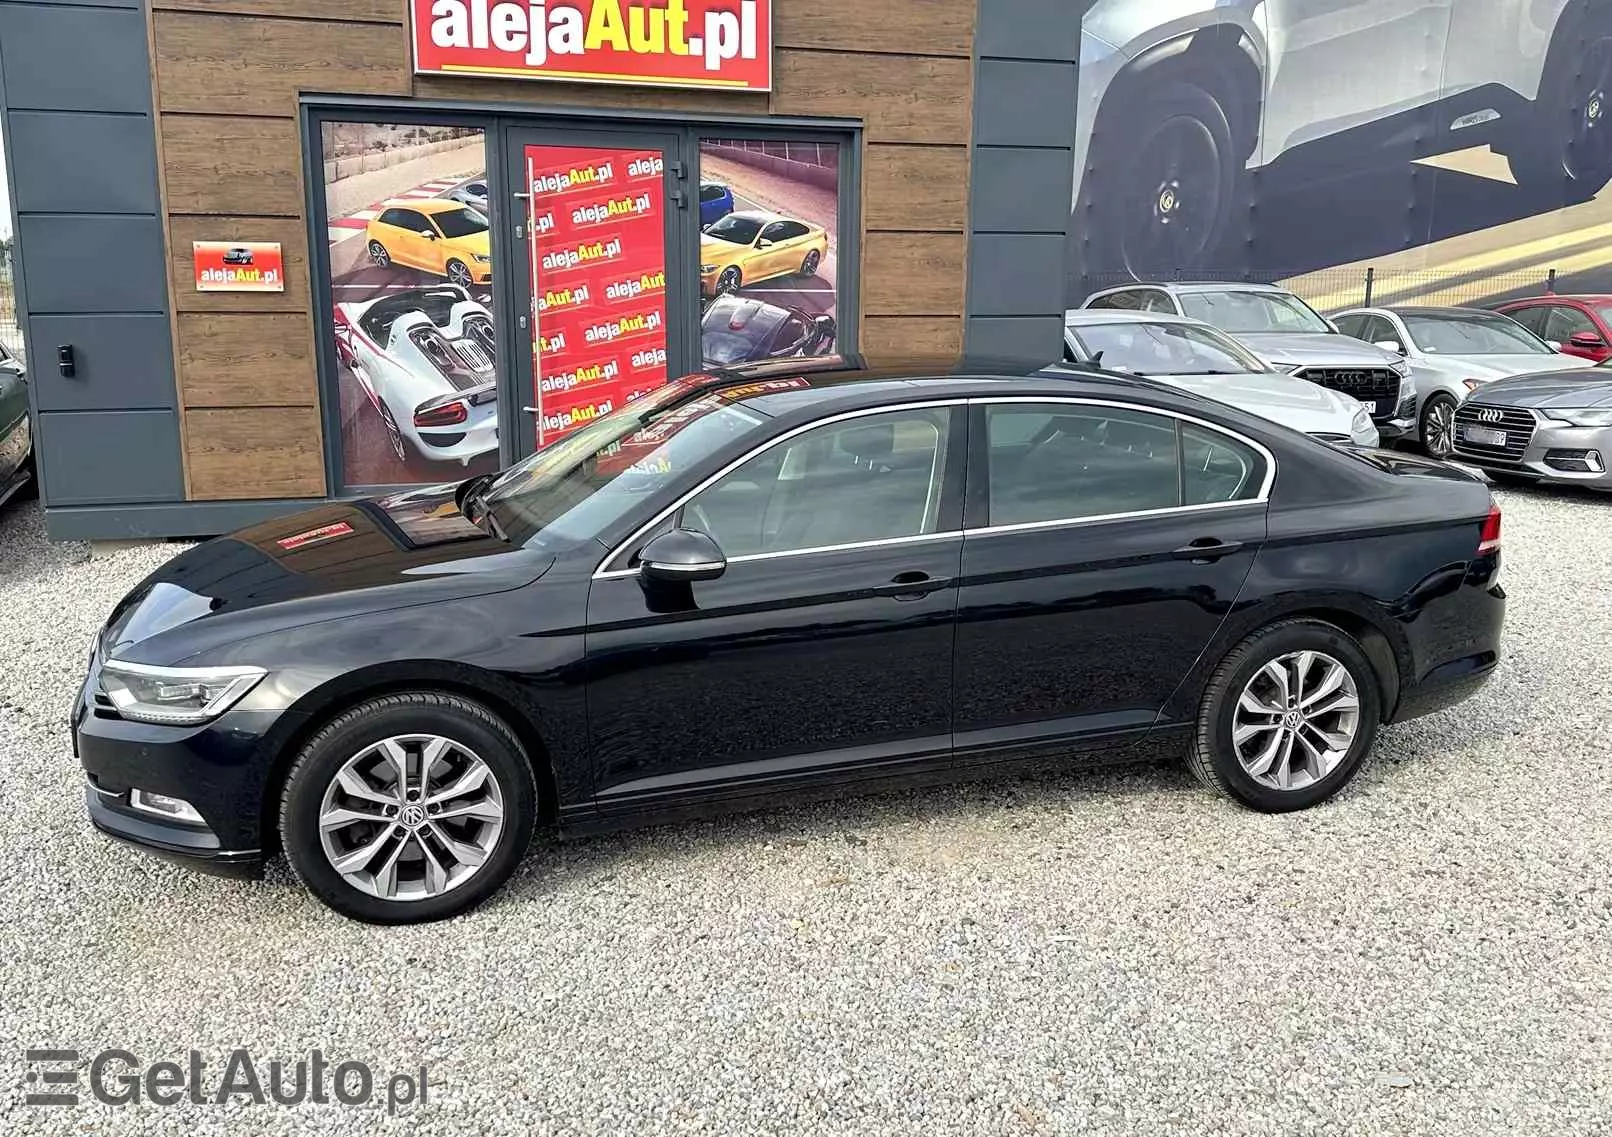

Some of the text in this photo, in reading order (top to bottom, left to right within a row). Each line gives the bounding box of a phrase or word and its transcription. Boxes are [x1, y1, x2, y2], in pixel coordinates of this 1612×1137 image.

[431, 0, 757, 70] alejaAut.pl
[533, 162, 614, 192] alejaAut.pl
[627, 156, 664, 176] aleja
[572, 193, 651, 223] alejaAut.pl
[542, 238, 622, 269] alejaAut.pl
[201, 267, 278, 285] alejaAut.pl
[606, 271, 666, 298] alejaAut
[584, 310, 662, 342] alejaAut.pl
[631, 347, 667, 368] aleja
[541, 359, 619, 392] alejaAut.pl
